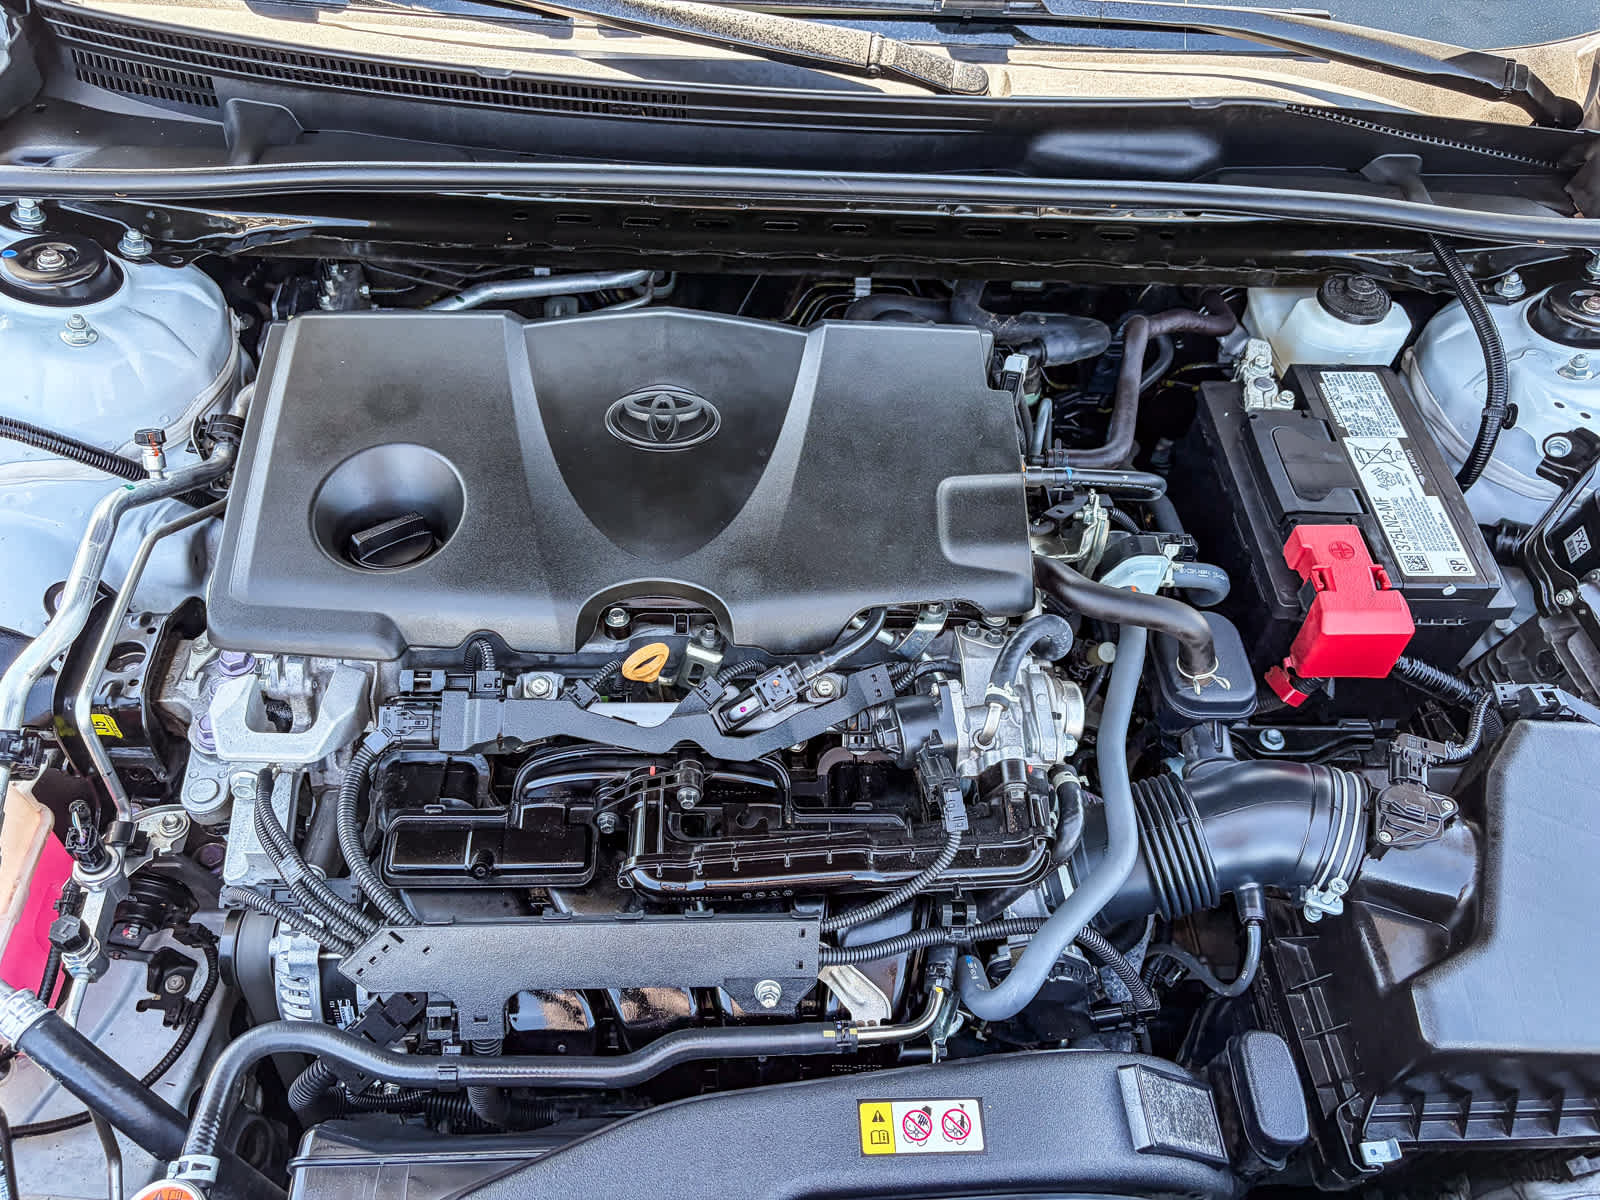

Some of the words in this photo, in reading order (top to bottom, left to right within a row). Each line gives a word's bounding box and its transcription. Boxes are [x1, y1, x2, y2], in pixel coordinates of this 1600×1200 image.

[1405, 448, 1422, 475] CLARIOS
[1373, 496, 1411, 551] 375LN2-MF
[1574, 529, 1588, 554] FX2
[1449, 559, 1468, 572] SP
